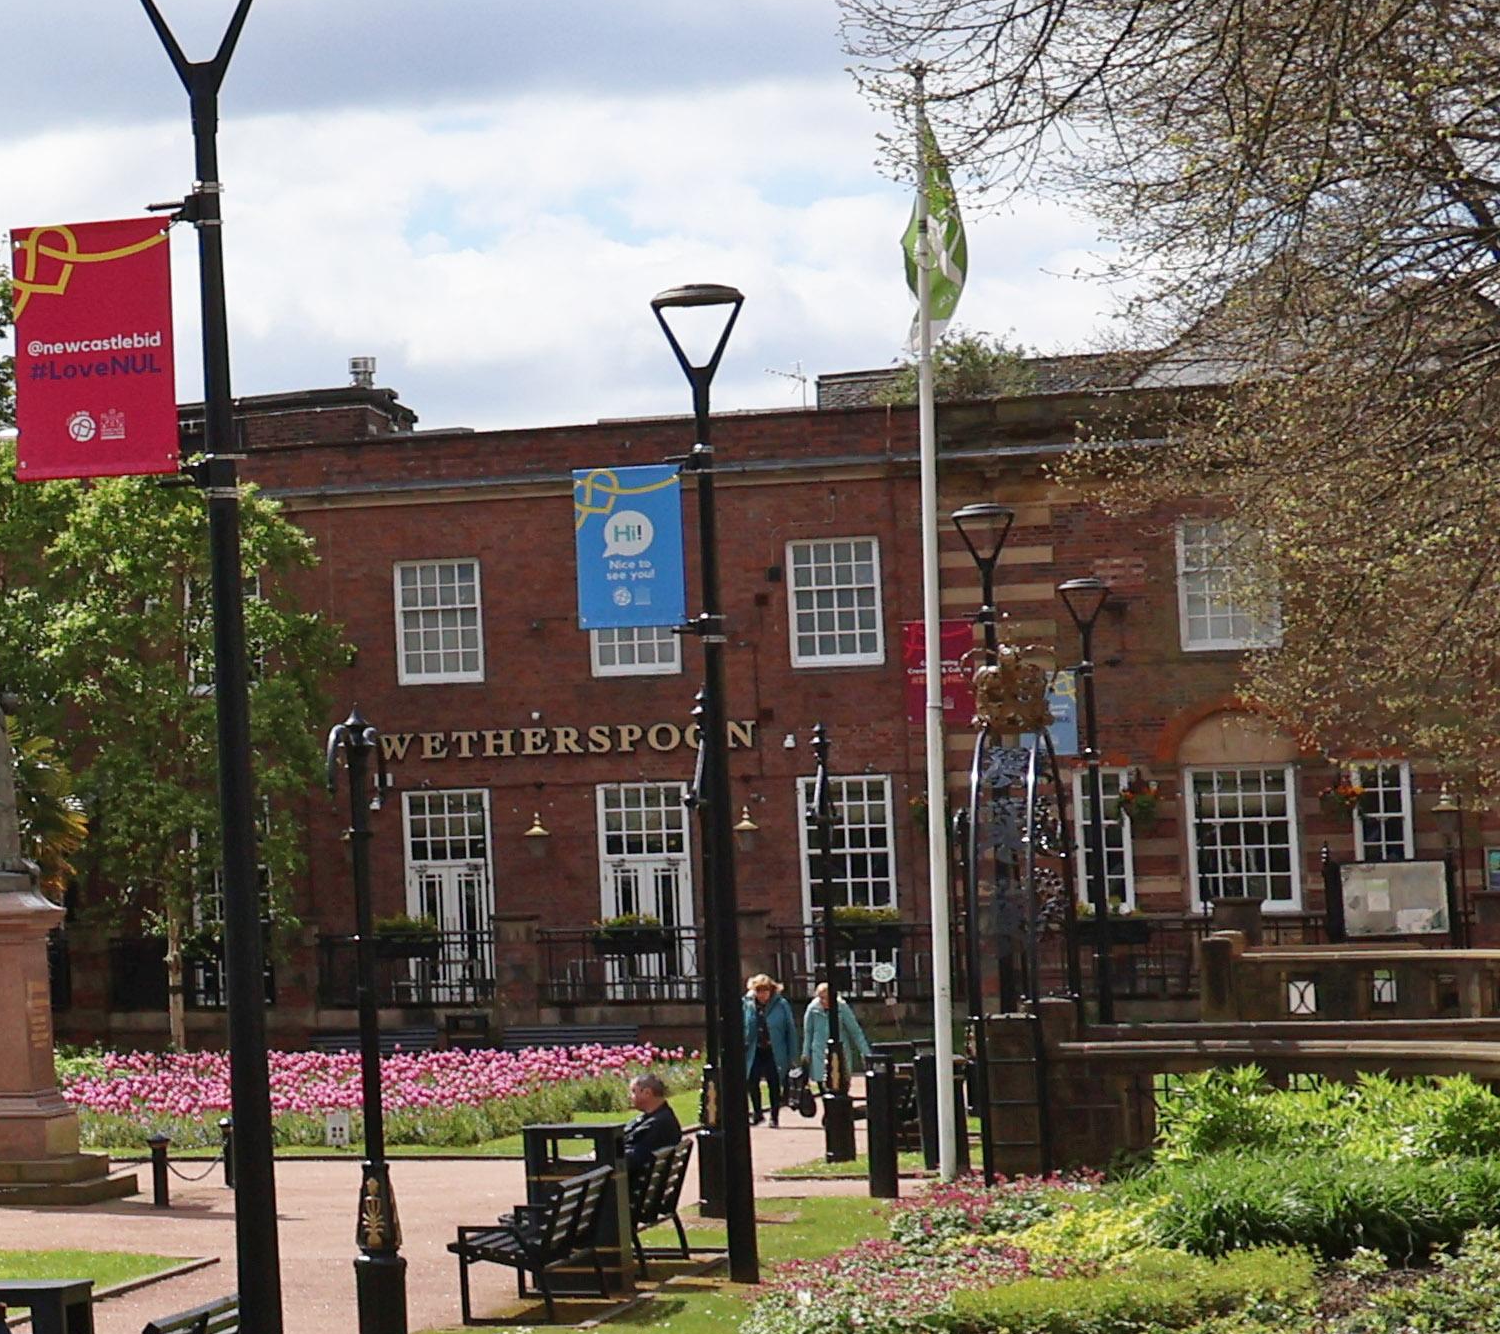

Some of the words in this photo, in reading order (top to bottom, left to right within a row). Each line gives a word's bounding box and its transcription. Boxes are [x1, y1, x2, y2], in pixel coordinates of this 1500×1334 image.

[27, 331, 161, 357] @newcastlebid
[30, 353, 162, 380] #LoveNUL
[613, 525, 642, 542] Hi!
[609, 560, 636, 570] Nice
[639, 559, 652, 568] to
[606, 571, 627, 580] see
[630, 569, 655, 581] you!
